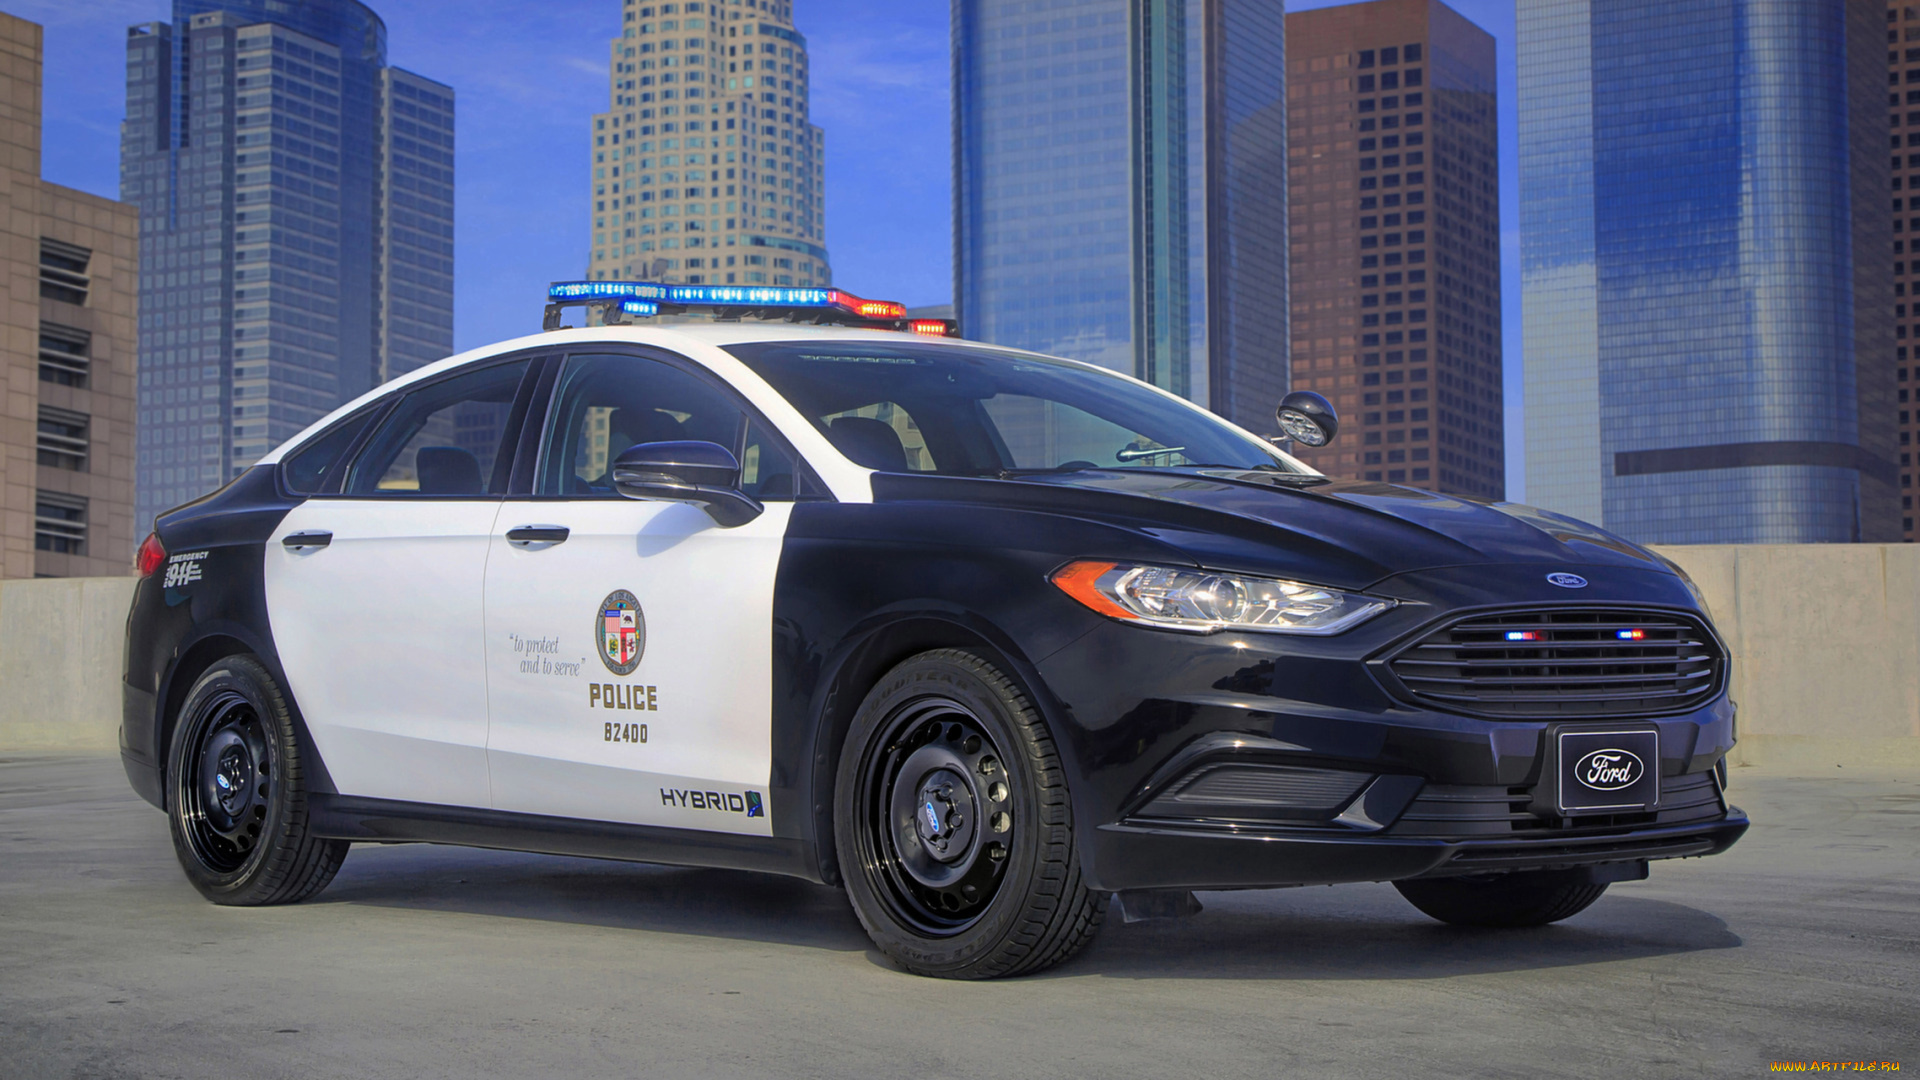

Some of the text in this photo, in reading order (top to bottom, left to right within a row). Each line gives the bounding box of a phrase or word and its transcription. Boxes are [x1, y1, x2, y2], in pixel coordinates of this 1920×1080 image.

[169, 551, 209, 564] EMERGENCY
[168, 561, 193, 588] 911
[526, 636, 559, 657] protect
[520, 654, 540, 674] and
[542, 657, 552, 675] to
[589, 683, 658, 711] POLICE
[604, 722, 648, 743] 82400
[1587, 754, 1632, 783] Ford
[660, 788, 744, 812] HYBRID
